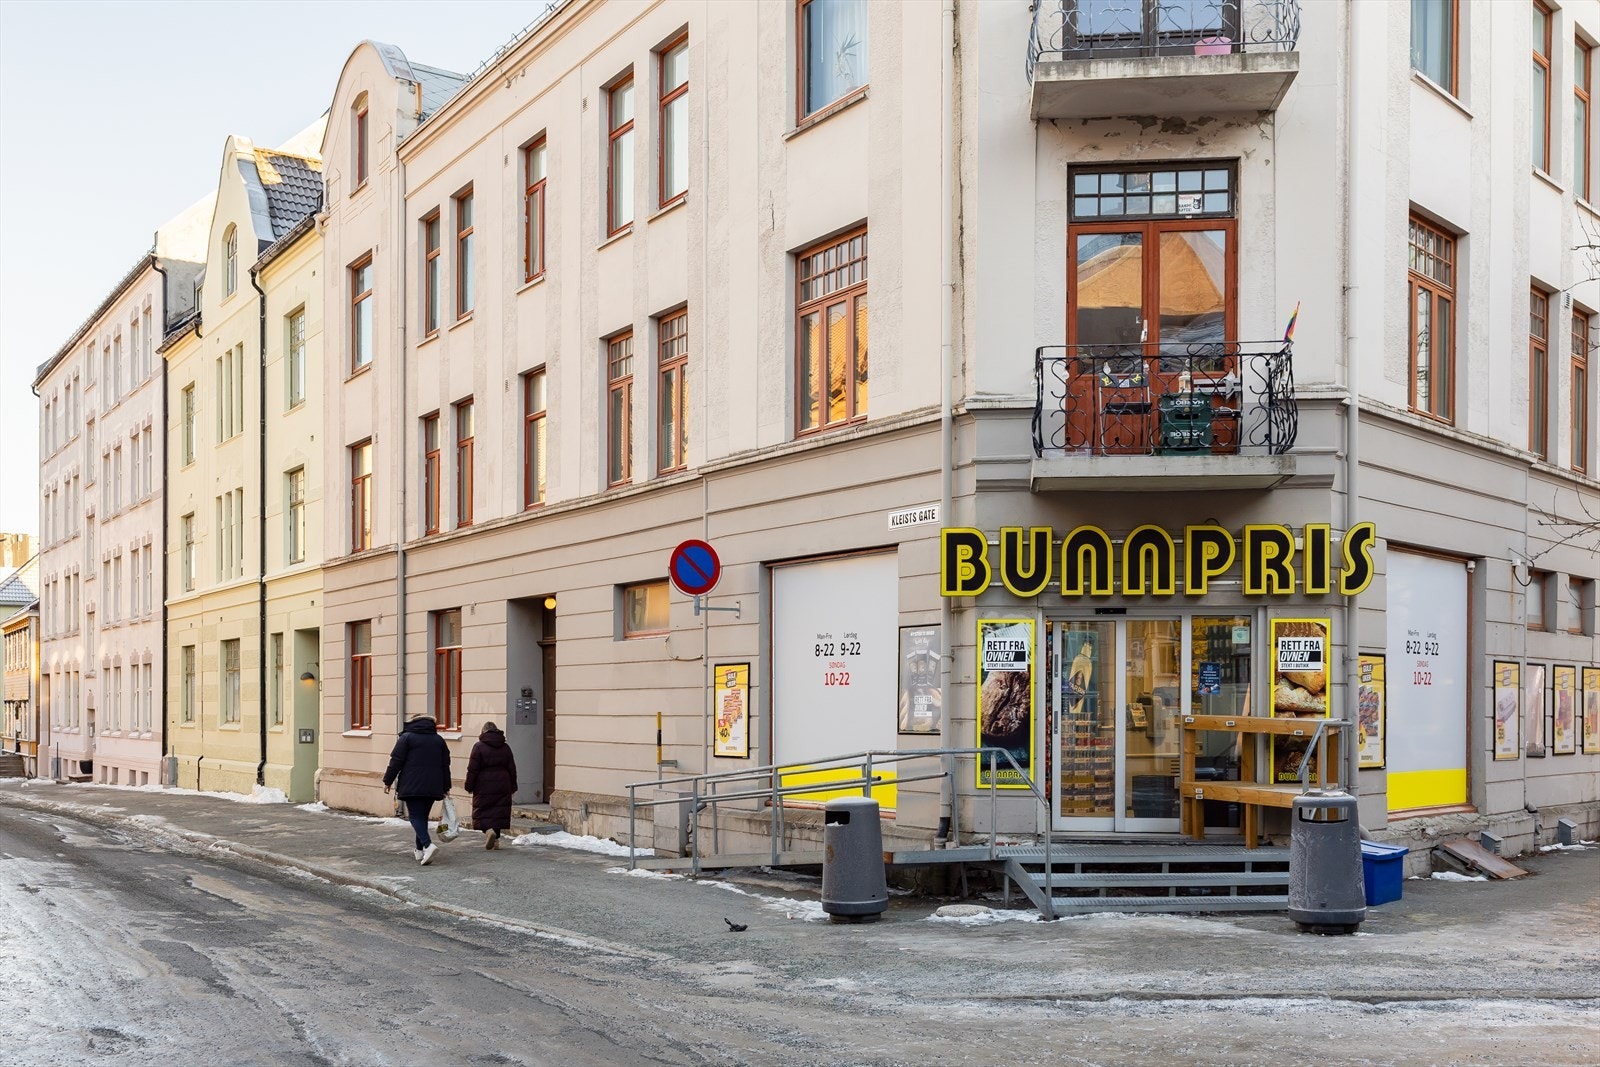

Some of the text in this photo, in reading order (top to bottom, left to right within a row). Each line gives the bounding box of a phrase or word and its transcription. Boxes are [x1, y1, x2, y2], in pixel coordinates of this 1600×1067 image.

[891, 509, 936, 526] KLEISTS GATE
[940, 521, 1376, 598] BUNNPRIS
[843, 632, 858, 640] Lørdag
[815, 642, 861, 657] 8-22 9-22
[987, 640, 1025, 651] RETT FRA
[1281, 640, 1321, 651] RETT FRA
[1406, 640, 1439, 656] 8-22 9-22
[986, 651, 1016, 662] OVNEN
[1280, 651, 1310, 662] OVNEN
[824, 672, 850, 686] 10-22
[1413, 671, 1432, 686] 10-22
